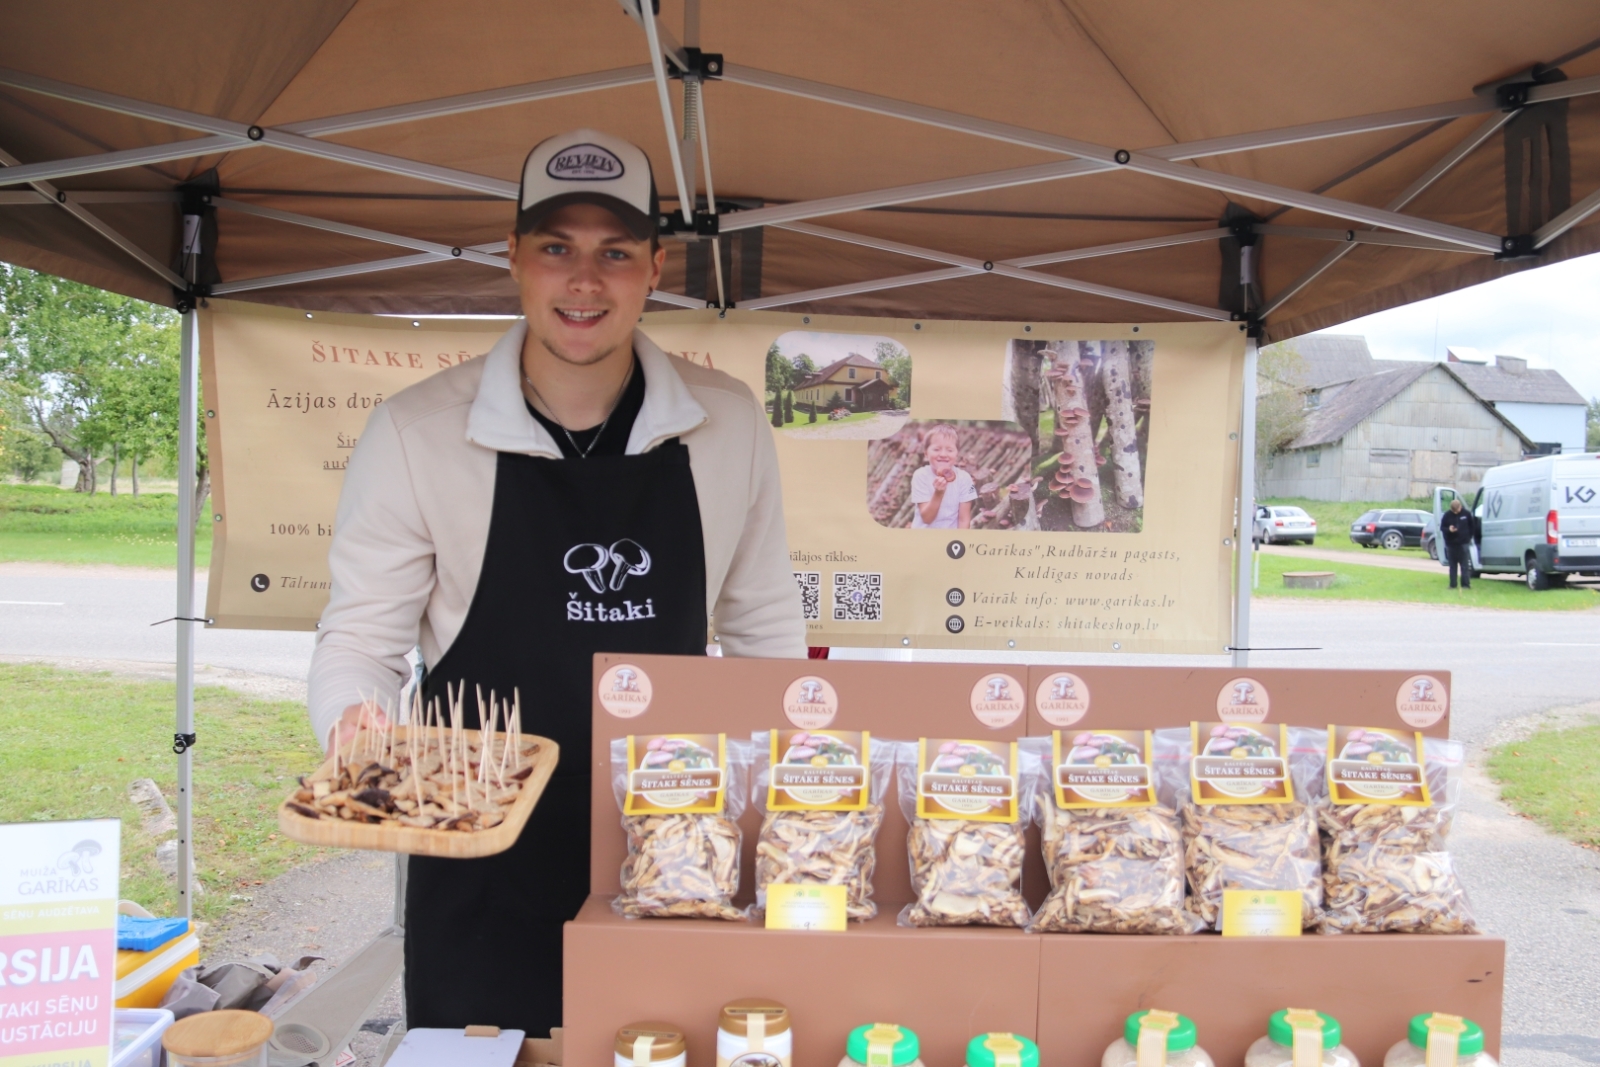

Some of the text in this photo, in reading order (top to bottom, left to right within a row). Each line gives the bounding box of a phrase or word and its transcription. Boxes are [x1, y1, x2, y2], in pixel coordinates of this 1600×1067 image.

[554, 154, 616, 172] REVIEW
[311, 339, 424, 369] ŠITAKE
[437, 350, 488, 369] SĒ
[266, 388, 336, 414] Āzijas
[270, 523, 332, 536] 100% bi
[825, 551, 858, 562] tīklos:
[1124, 548, 1180, 563] pagasts,
[1014, 566, 1134, 584] Kuldīgas novads
[566, 591, 656, 622] Šitaki
[972, 591, 1175, 610] Vairāk info: www.garikas.lv
[974, 616, 1160, 634] E-veikals: shitakeshop.lv
[603, 692, 648, 703] GARĪKAS
[788, 704, 833, 714] GARĪKAS
[975, 702, 1020, 711] GARĪKAS
[1040, 700, 1085, 710] GARĪKAS
[1221, 706, 1265, 714] GARĪKAS
[1400, 703, 1443, 712] GARĪKAS
[1204, 766, 1276, 776] ŠITAKE SĒNES
[1341, 769, 1413, 781] ŠITAKE SĒNES
[641, 778, 712, 789] ŠITAKE SĒNES
[783, 773, 854, 784] ŠITAKE SĒNES
[1068, 772, 1139, 783] ŠITAKE SĒNES
[931, 782, 1004, 794] ŠITAKE SĒNES
[20, 866, 58, 877] MUIŽA
[18, 877, 99, 896] GARĪKAS
[38, 906, 100, 918] AUDZĒTAVA
[45, 994, 98, 1016] SĒŅU
[1, 1018, 98, 1044] USTĀCIJU
